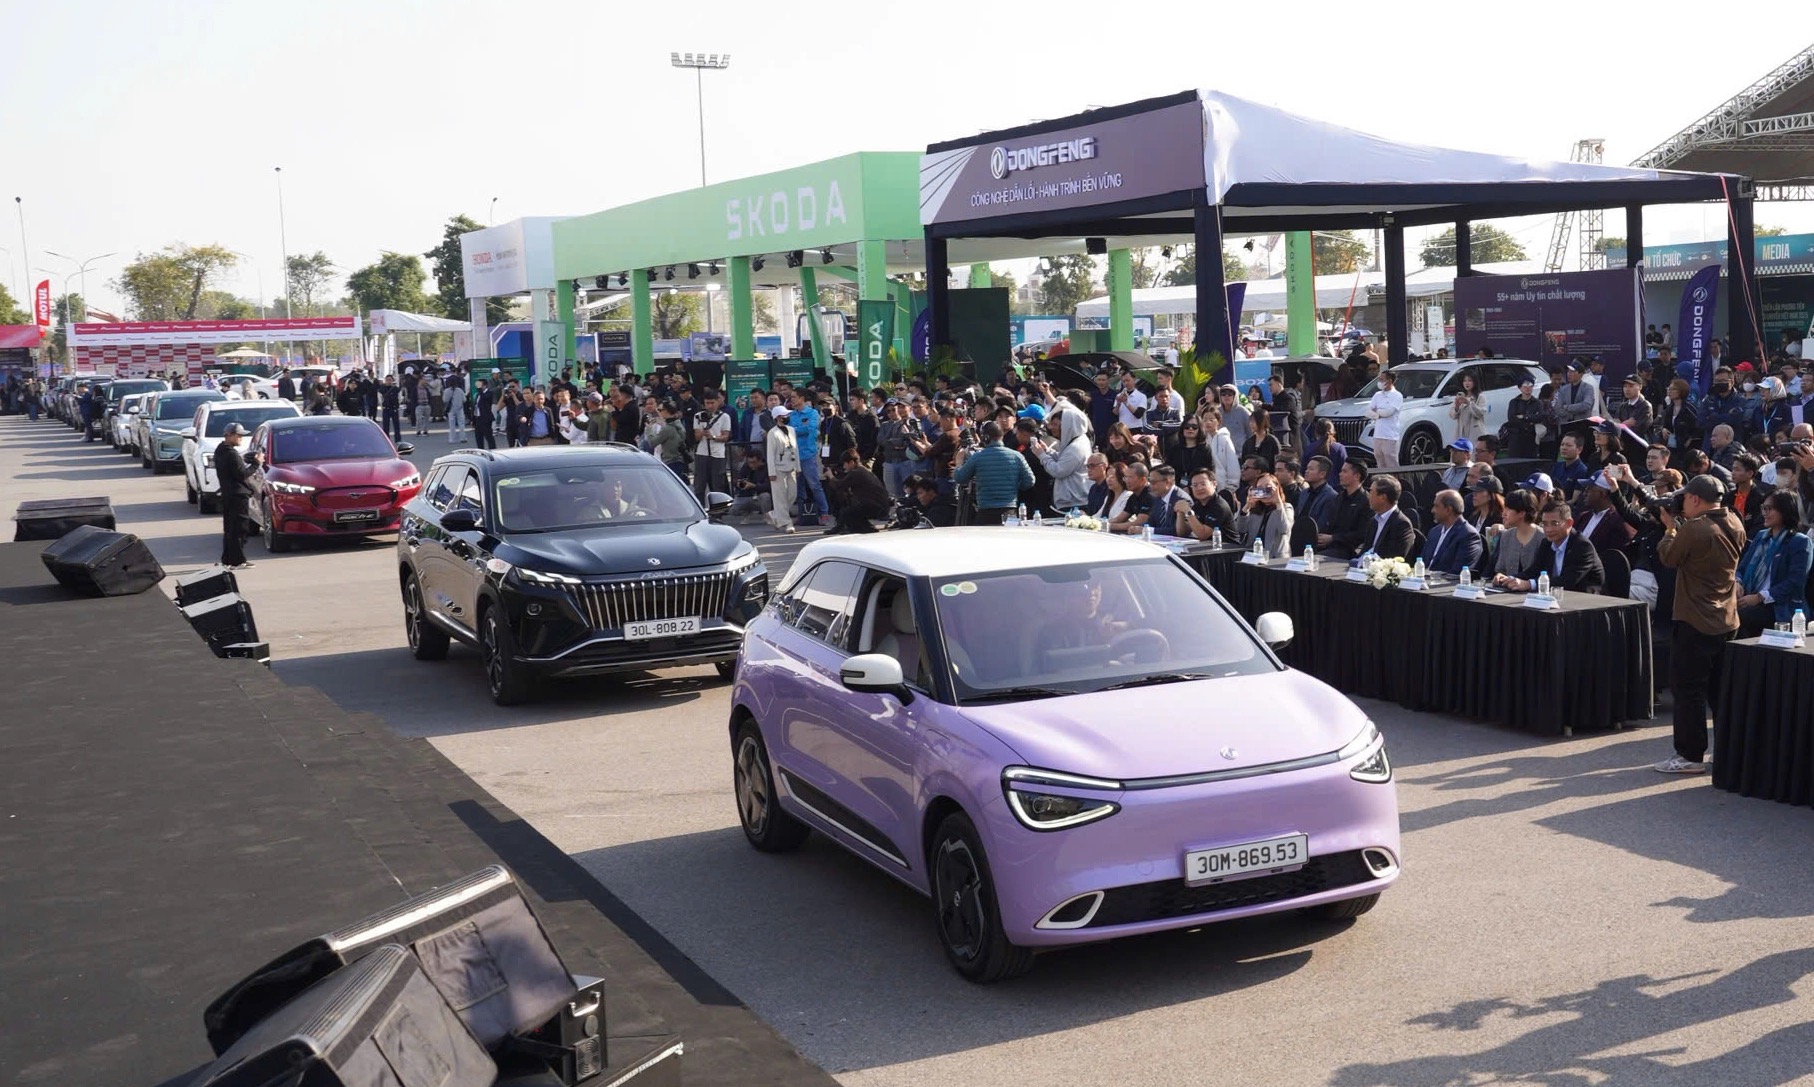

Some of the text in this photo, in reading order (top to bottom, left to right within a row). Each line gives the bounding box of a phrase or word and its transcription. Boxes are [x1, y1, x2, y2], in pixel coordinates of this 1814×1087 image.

[1008, 137, 1095, 171] DONGFENG
[971, 191, 990, 207] CÔNG
[1039, 181, 1059, 198] HÀNH
[1060, 177, 1081, 196] TRÌNH
[726, 180, 847, 240] SKODA
[1762, 243, 1790, 261] MEDIA
[38, 288, 48, 320] MOTUL
[1691, 306, 1704, 382] DONGFEN
[631, 621, 694, 636] 30L-808.22
[1198, 842, 1297, 874] 30M-869.53
